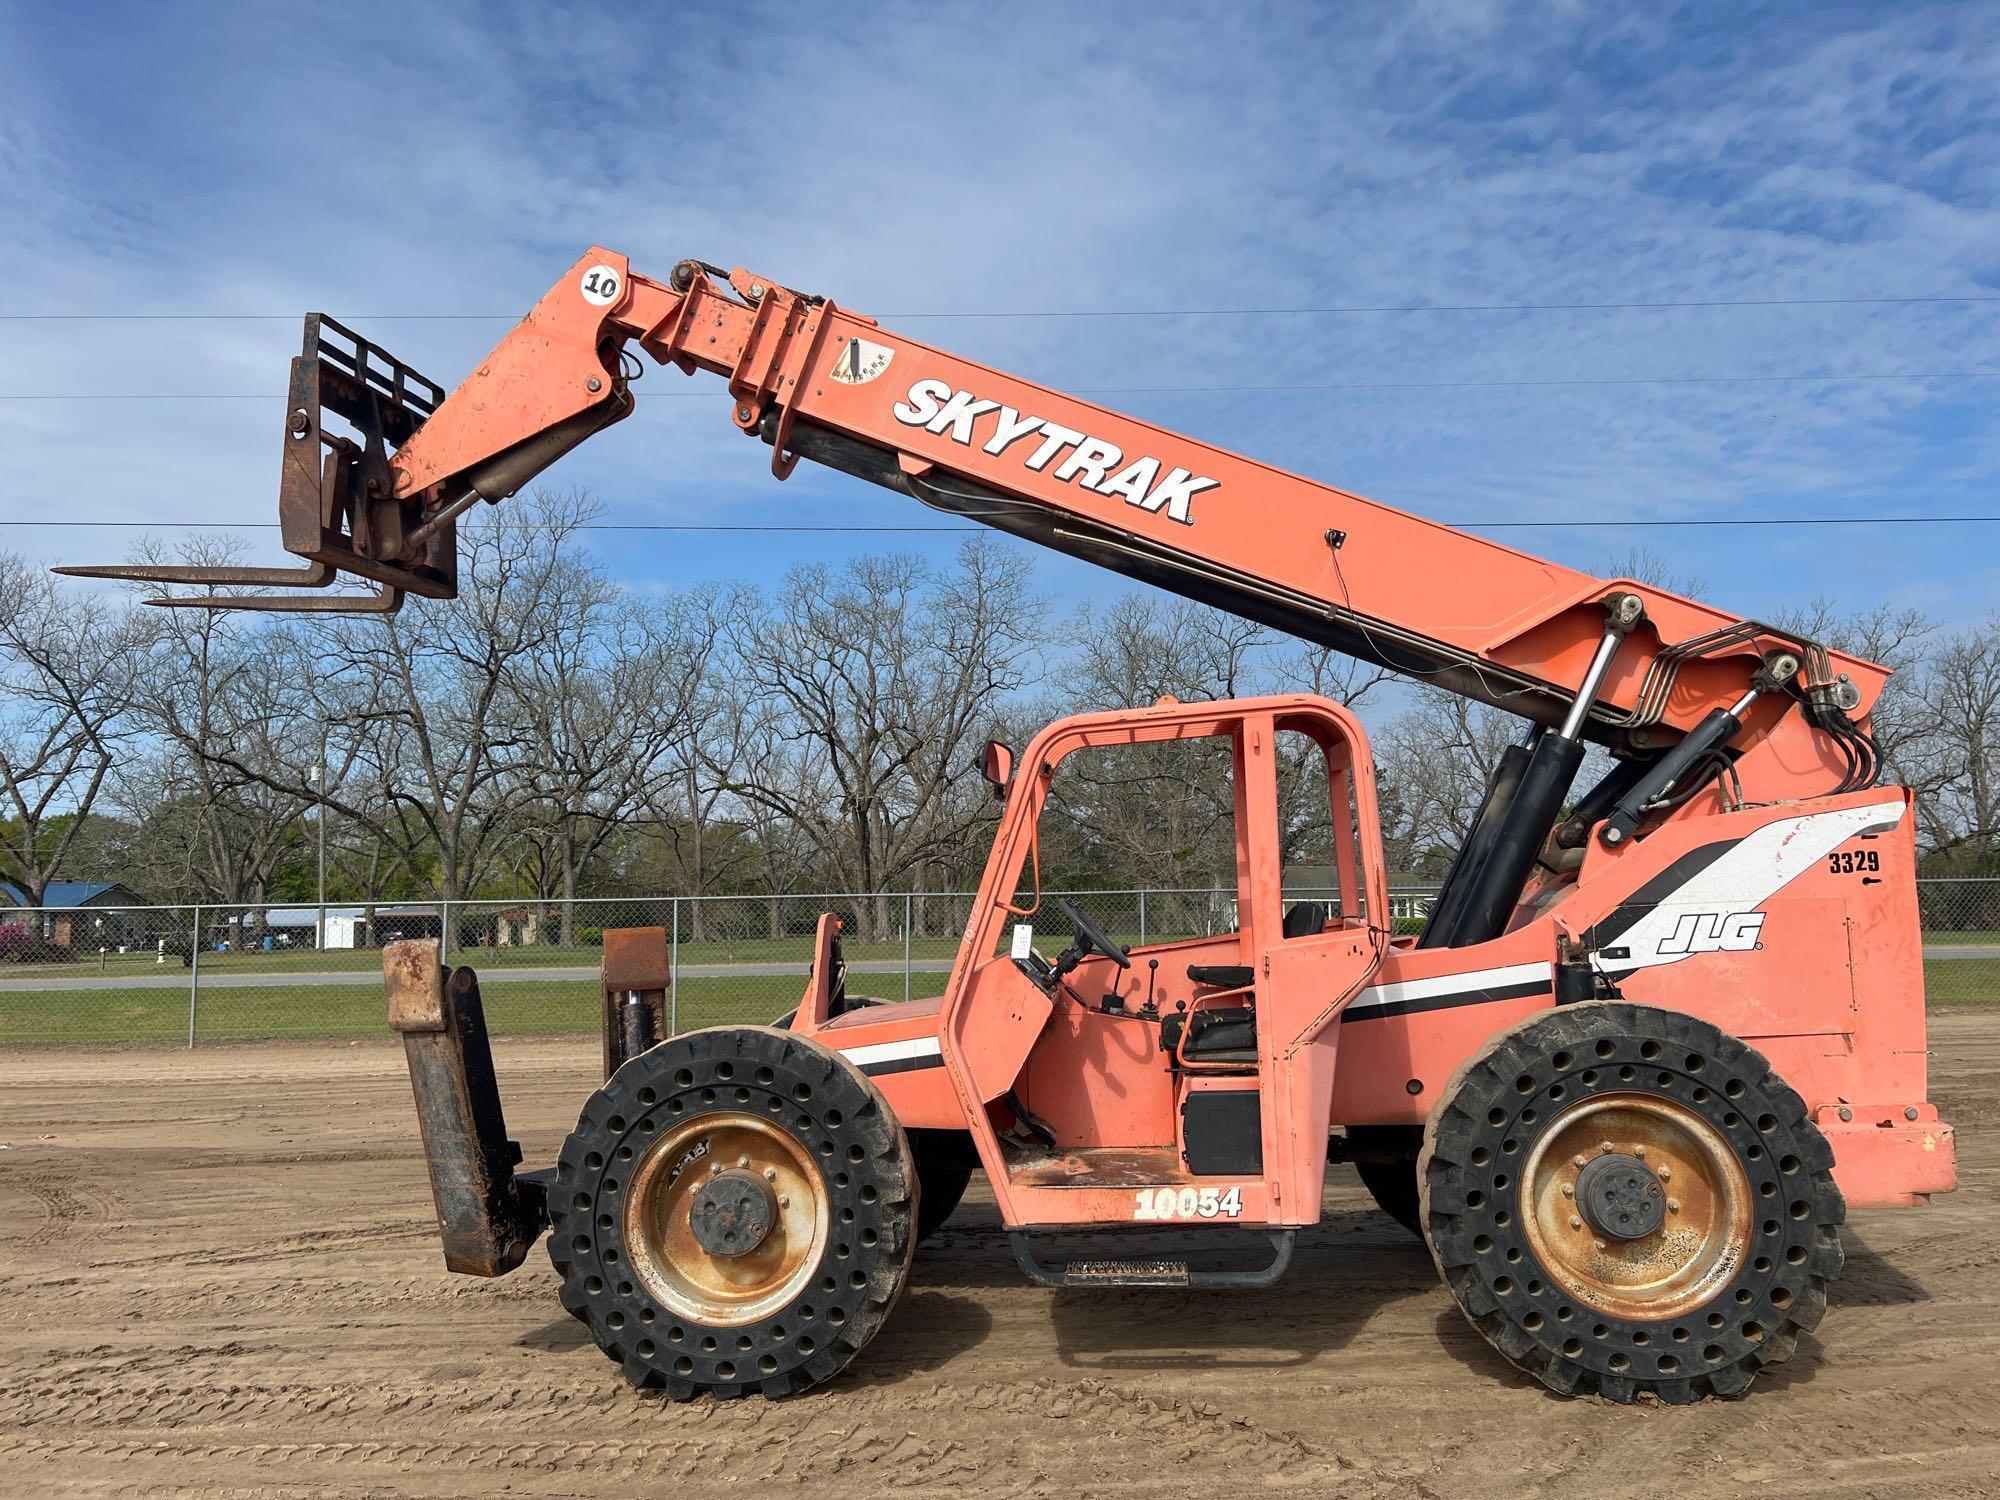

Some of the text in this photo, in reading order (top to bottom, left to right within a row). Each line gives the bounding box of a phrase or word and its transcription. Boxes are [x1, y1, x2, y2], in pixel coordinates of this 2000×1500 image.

[584, 273, 617, 298] 10
[893, 379, 1221, 525] SKYTRAK
[1829, 851, 1880, 873] 3329
[1656, 911, 1767, 955] JLG
[1133, 1186, 1242, 1219] 10054
